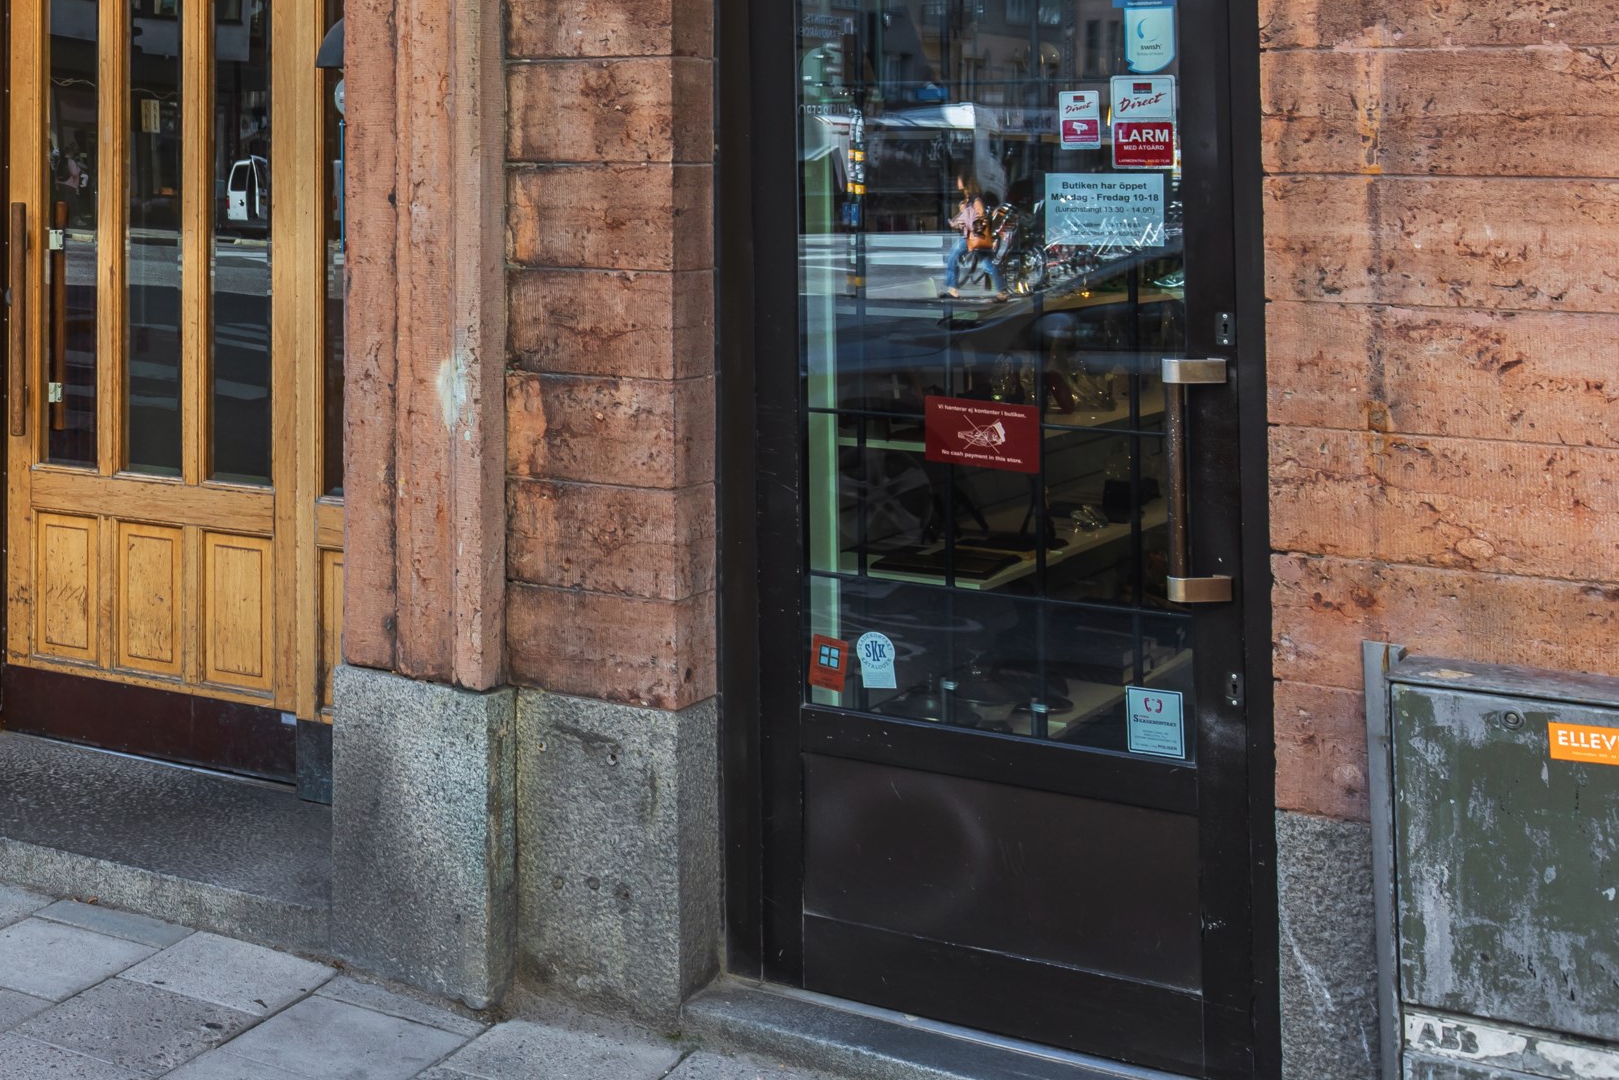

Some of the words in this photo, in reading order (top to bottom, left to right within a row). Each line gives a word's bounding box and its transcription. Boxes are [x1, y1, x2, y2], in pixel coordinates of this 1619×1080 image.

[1065, 101, 1093, 114] Direct
[1119, 92, 1167, 112] Direct
[1118, 129, 1169, 143] LARM
[1062, 182, 1101, 190] Butiken
[1101, 182, 1117, 190] har
[1119, 182, 1147, 191] öppet
[1051, 193, 1088, 202] Måndag
[1096, 193, 1130, 202] Fredag
[865, 640, 887, 661] SKK
[1558, 729, 1619, 751] ELLEV
[1417, 1022, 1479, 1054] ABB
